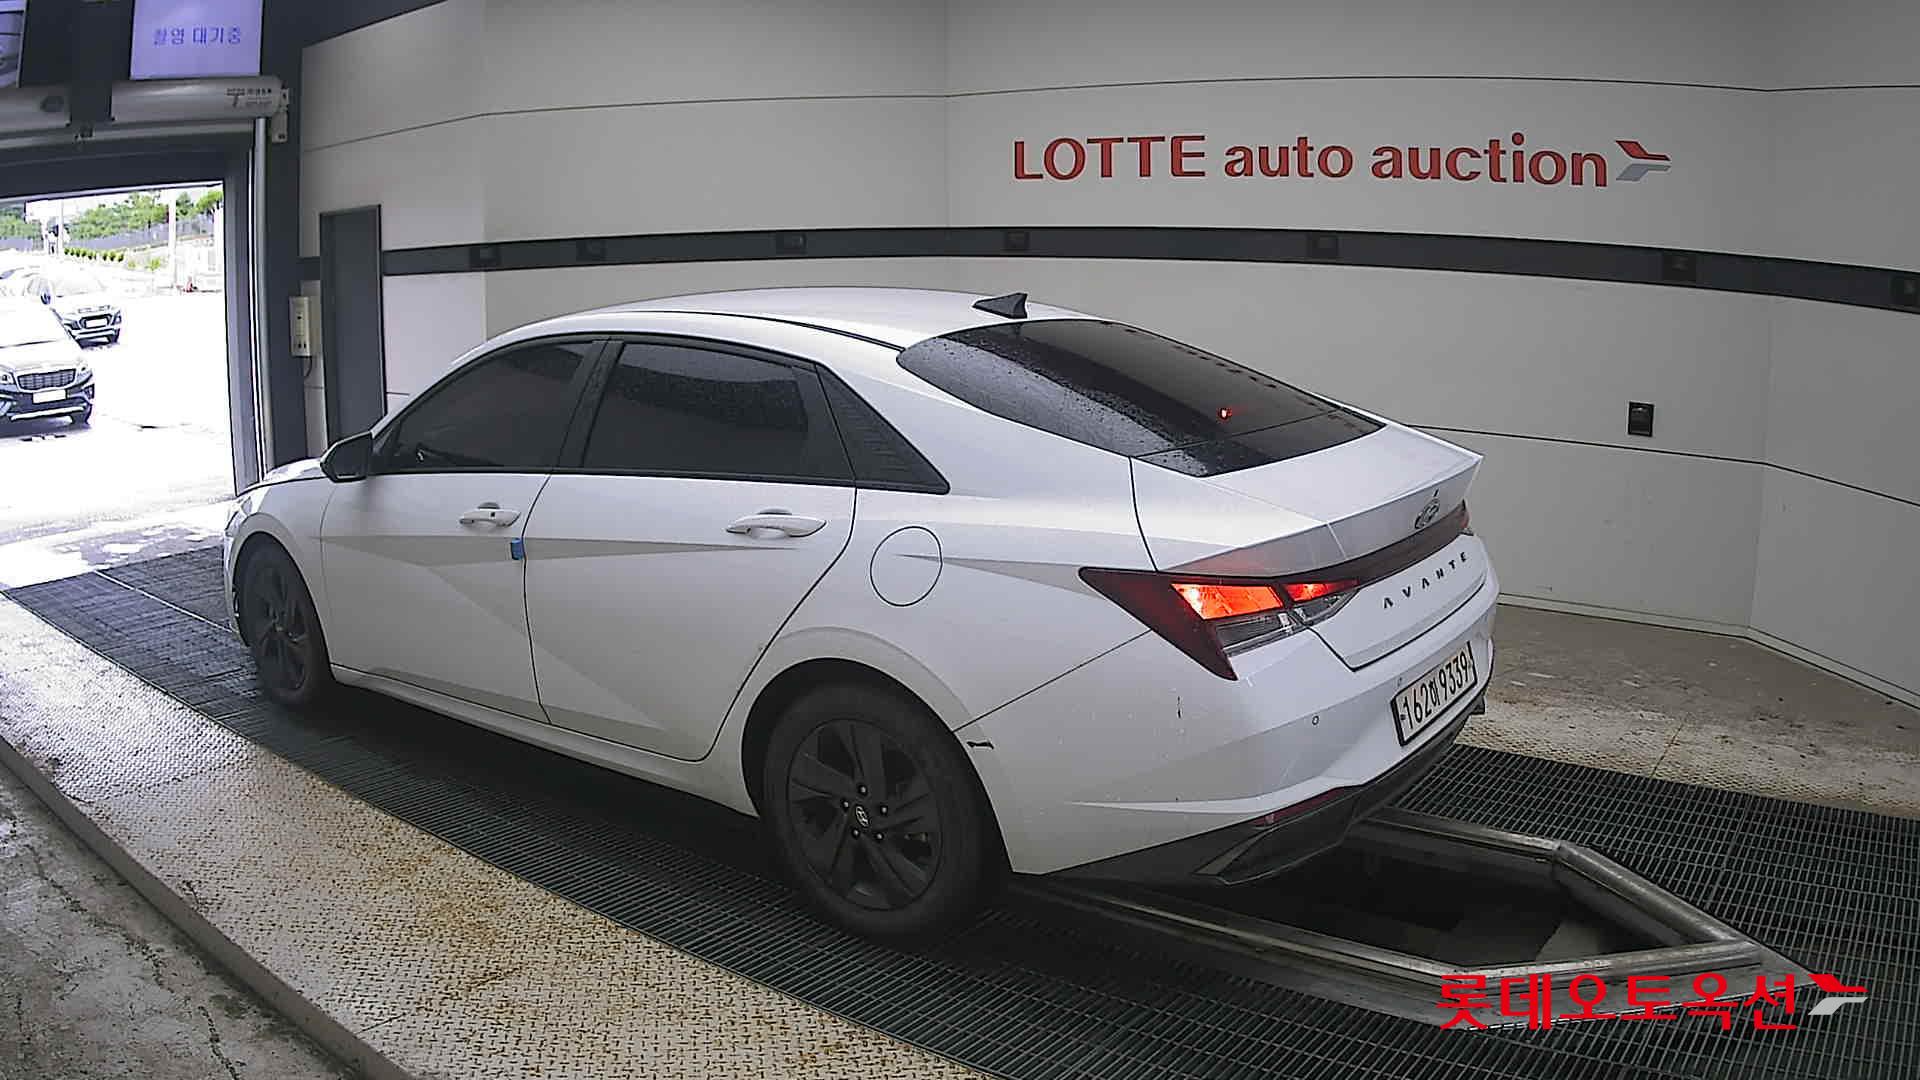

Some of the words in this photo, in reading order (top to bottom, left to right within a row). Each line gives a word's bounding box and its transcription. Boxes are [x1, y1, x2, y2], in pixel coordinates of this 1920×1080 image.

[1013, 135, 1206, 180] LOTTE
[1224, 135, 1354, 178] auto
[1371, 132, 1607, 187] auction
[1383, 551, 1467, 609] AVANTE
